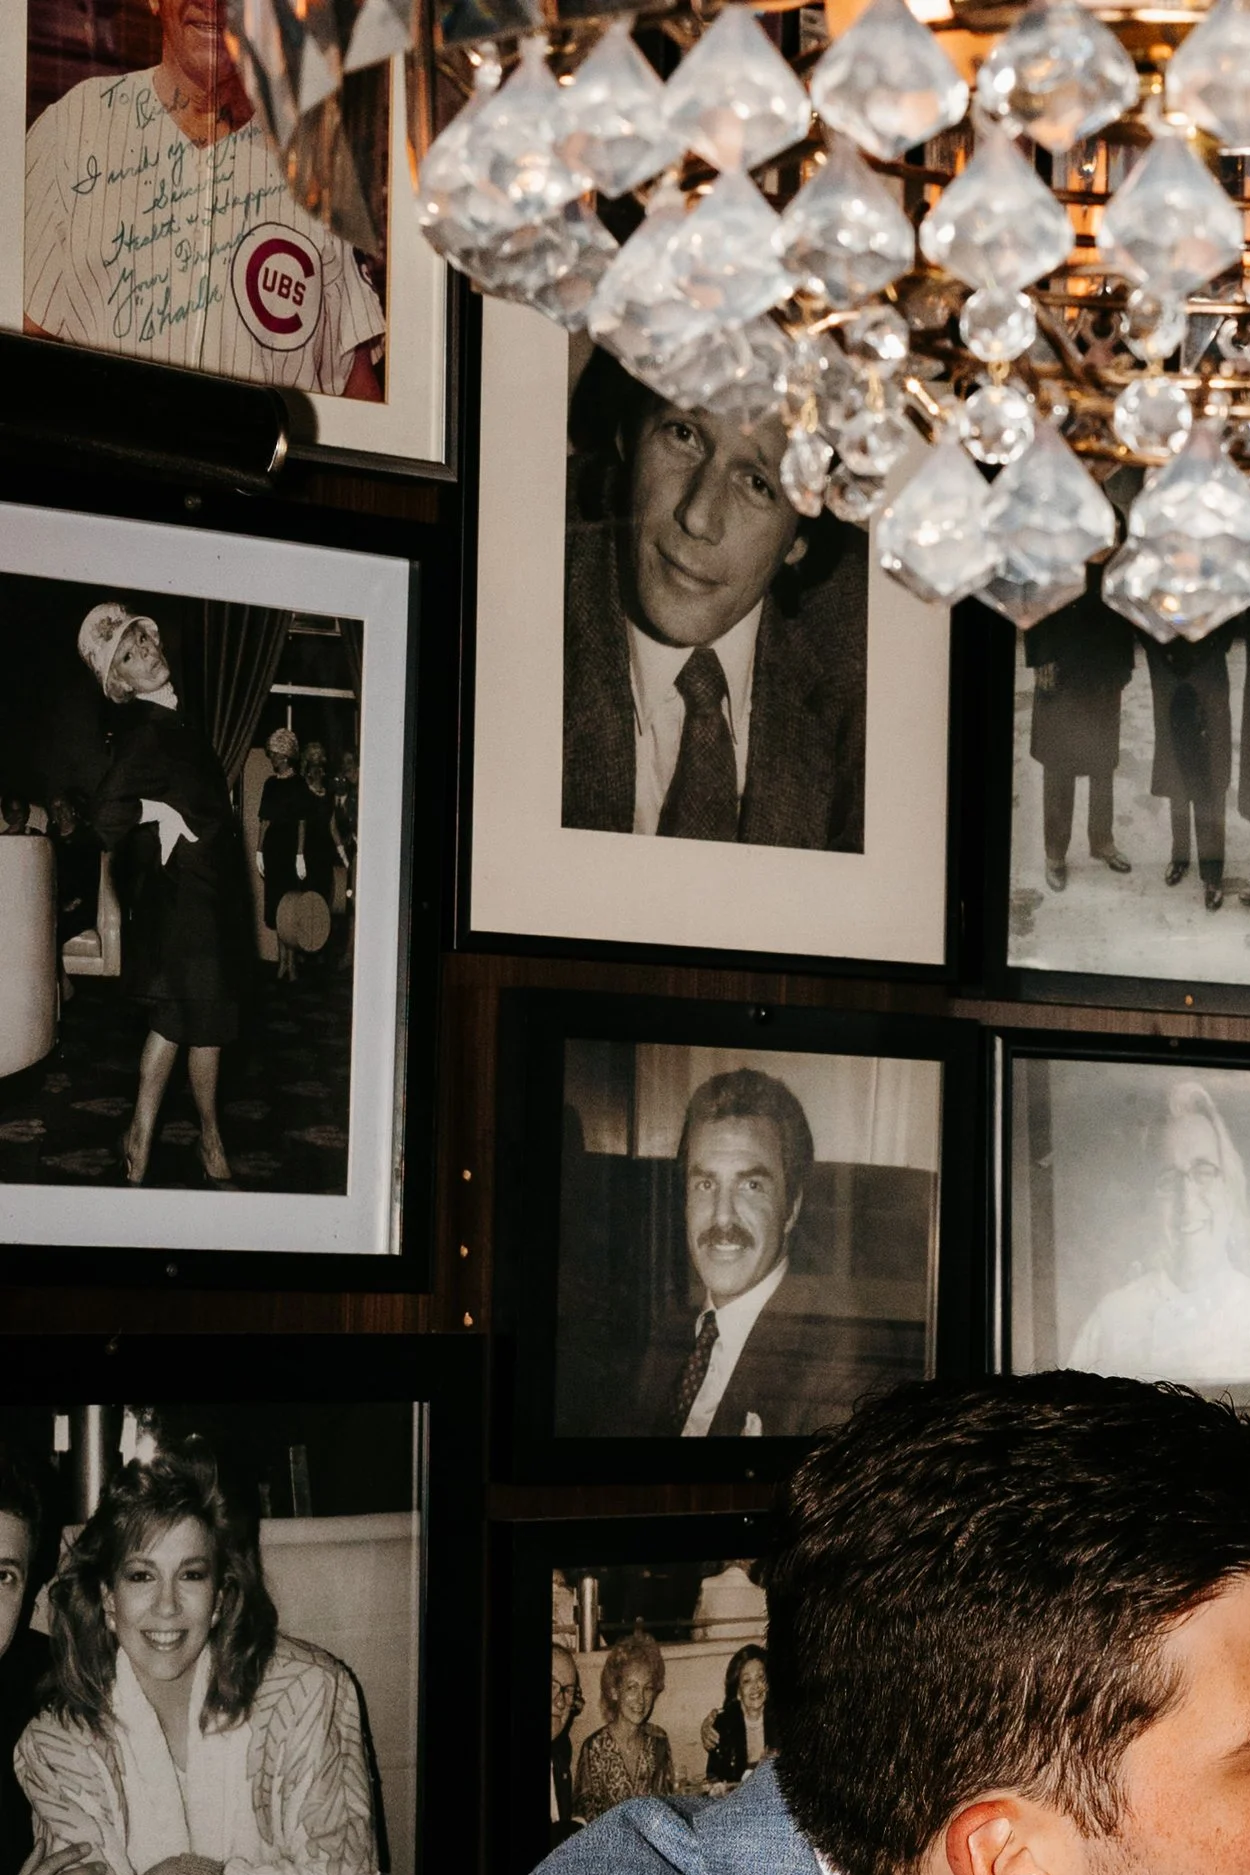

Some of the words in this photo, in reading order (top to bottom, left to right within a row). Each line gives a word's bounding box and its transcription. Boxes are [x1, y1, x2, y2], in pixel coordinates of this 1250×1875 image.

[101, 77, 128, 108] To
[103, 214, 180, 267] Health
[107, 267, 168, 339] Your
[246, 238, 315, 335] CUBS
